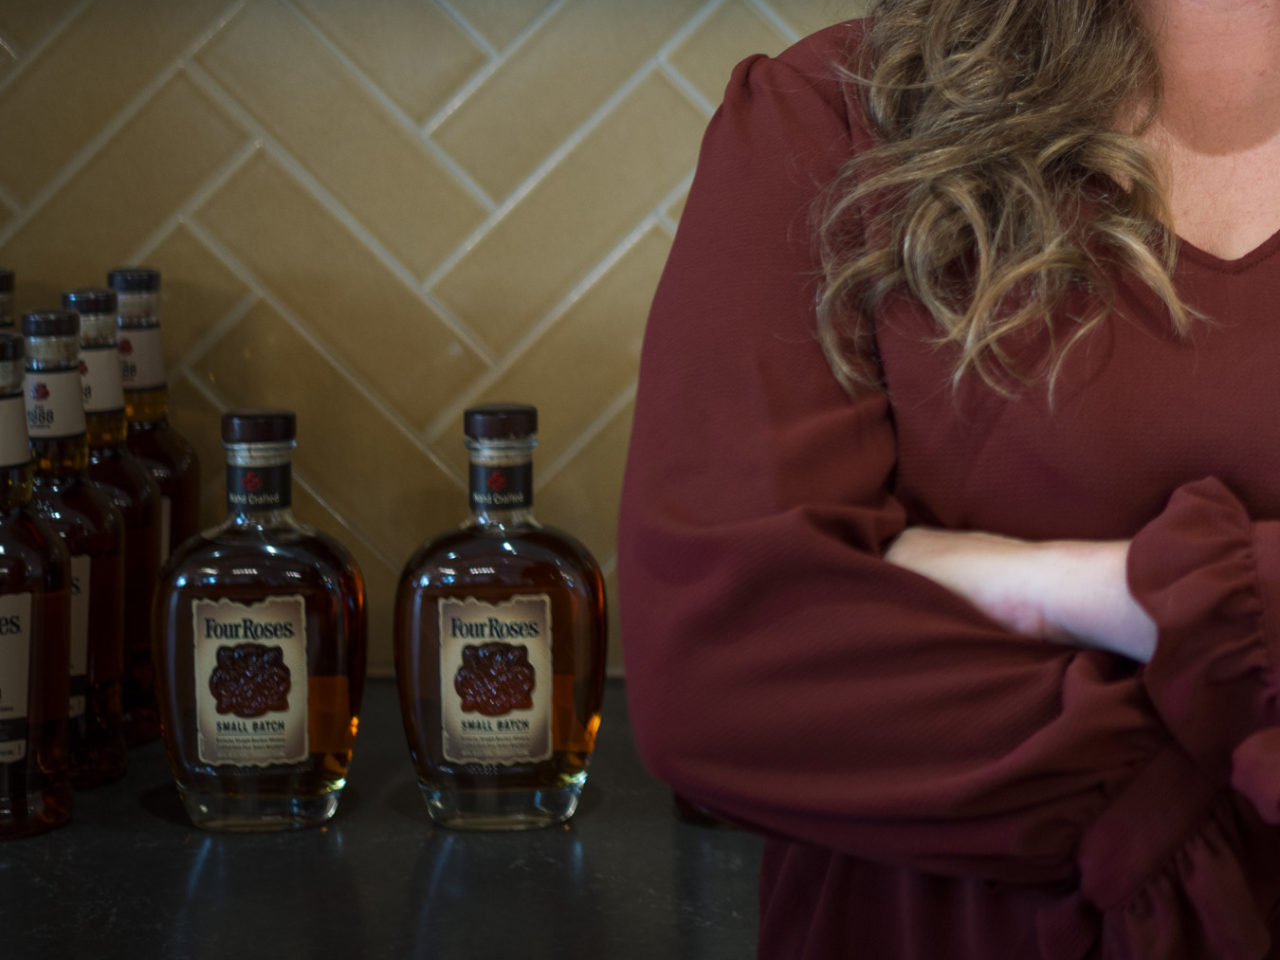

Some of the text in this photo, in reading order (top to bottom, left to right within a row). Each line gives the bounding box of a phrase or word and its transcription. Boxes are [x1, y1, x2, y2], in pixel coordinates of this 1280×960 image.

[248, 492, 280, 505] Crafted
[492, 492, 524, 505] Crafted
[204, 618, 295, 640] Four Roses
[451, 617, 540, 639] Four Roses
[216, 720, 285, 732] SMALL BATCH
[461, 720, 530, 732] SMALL BATCH
